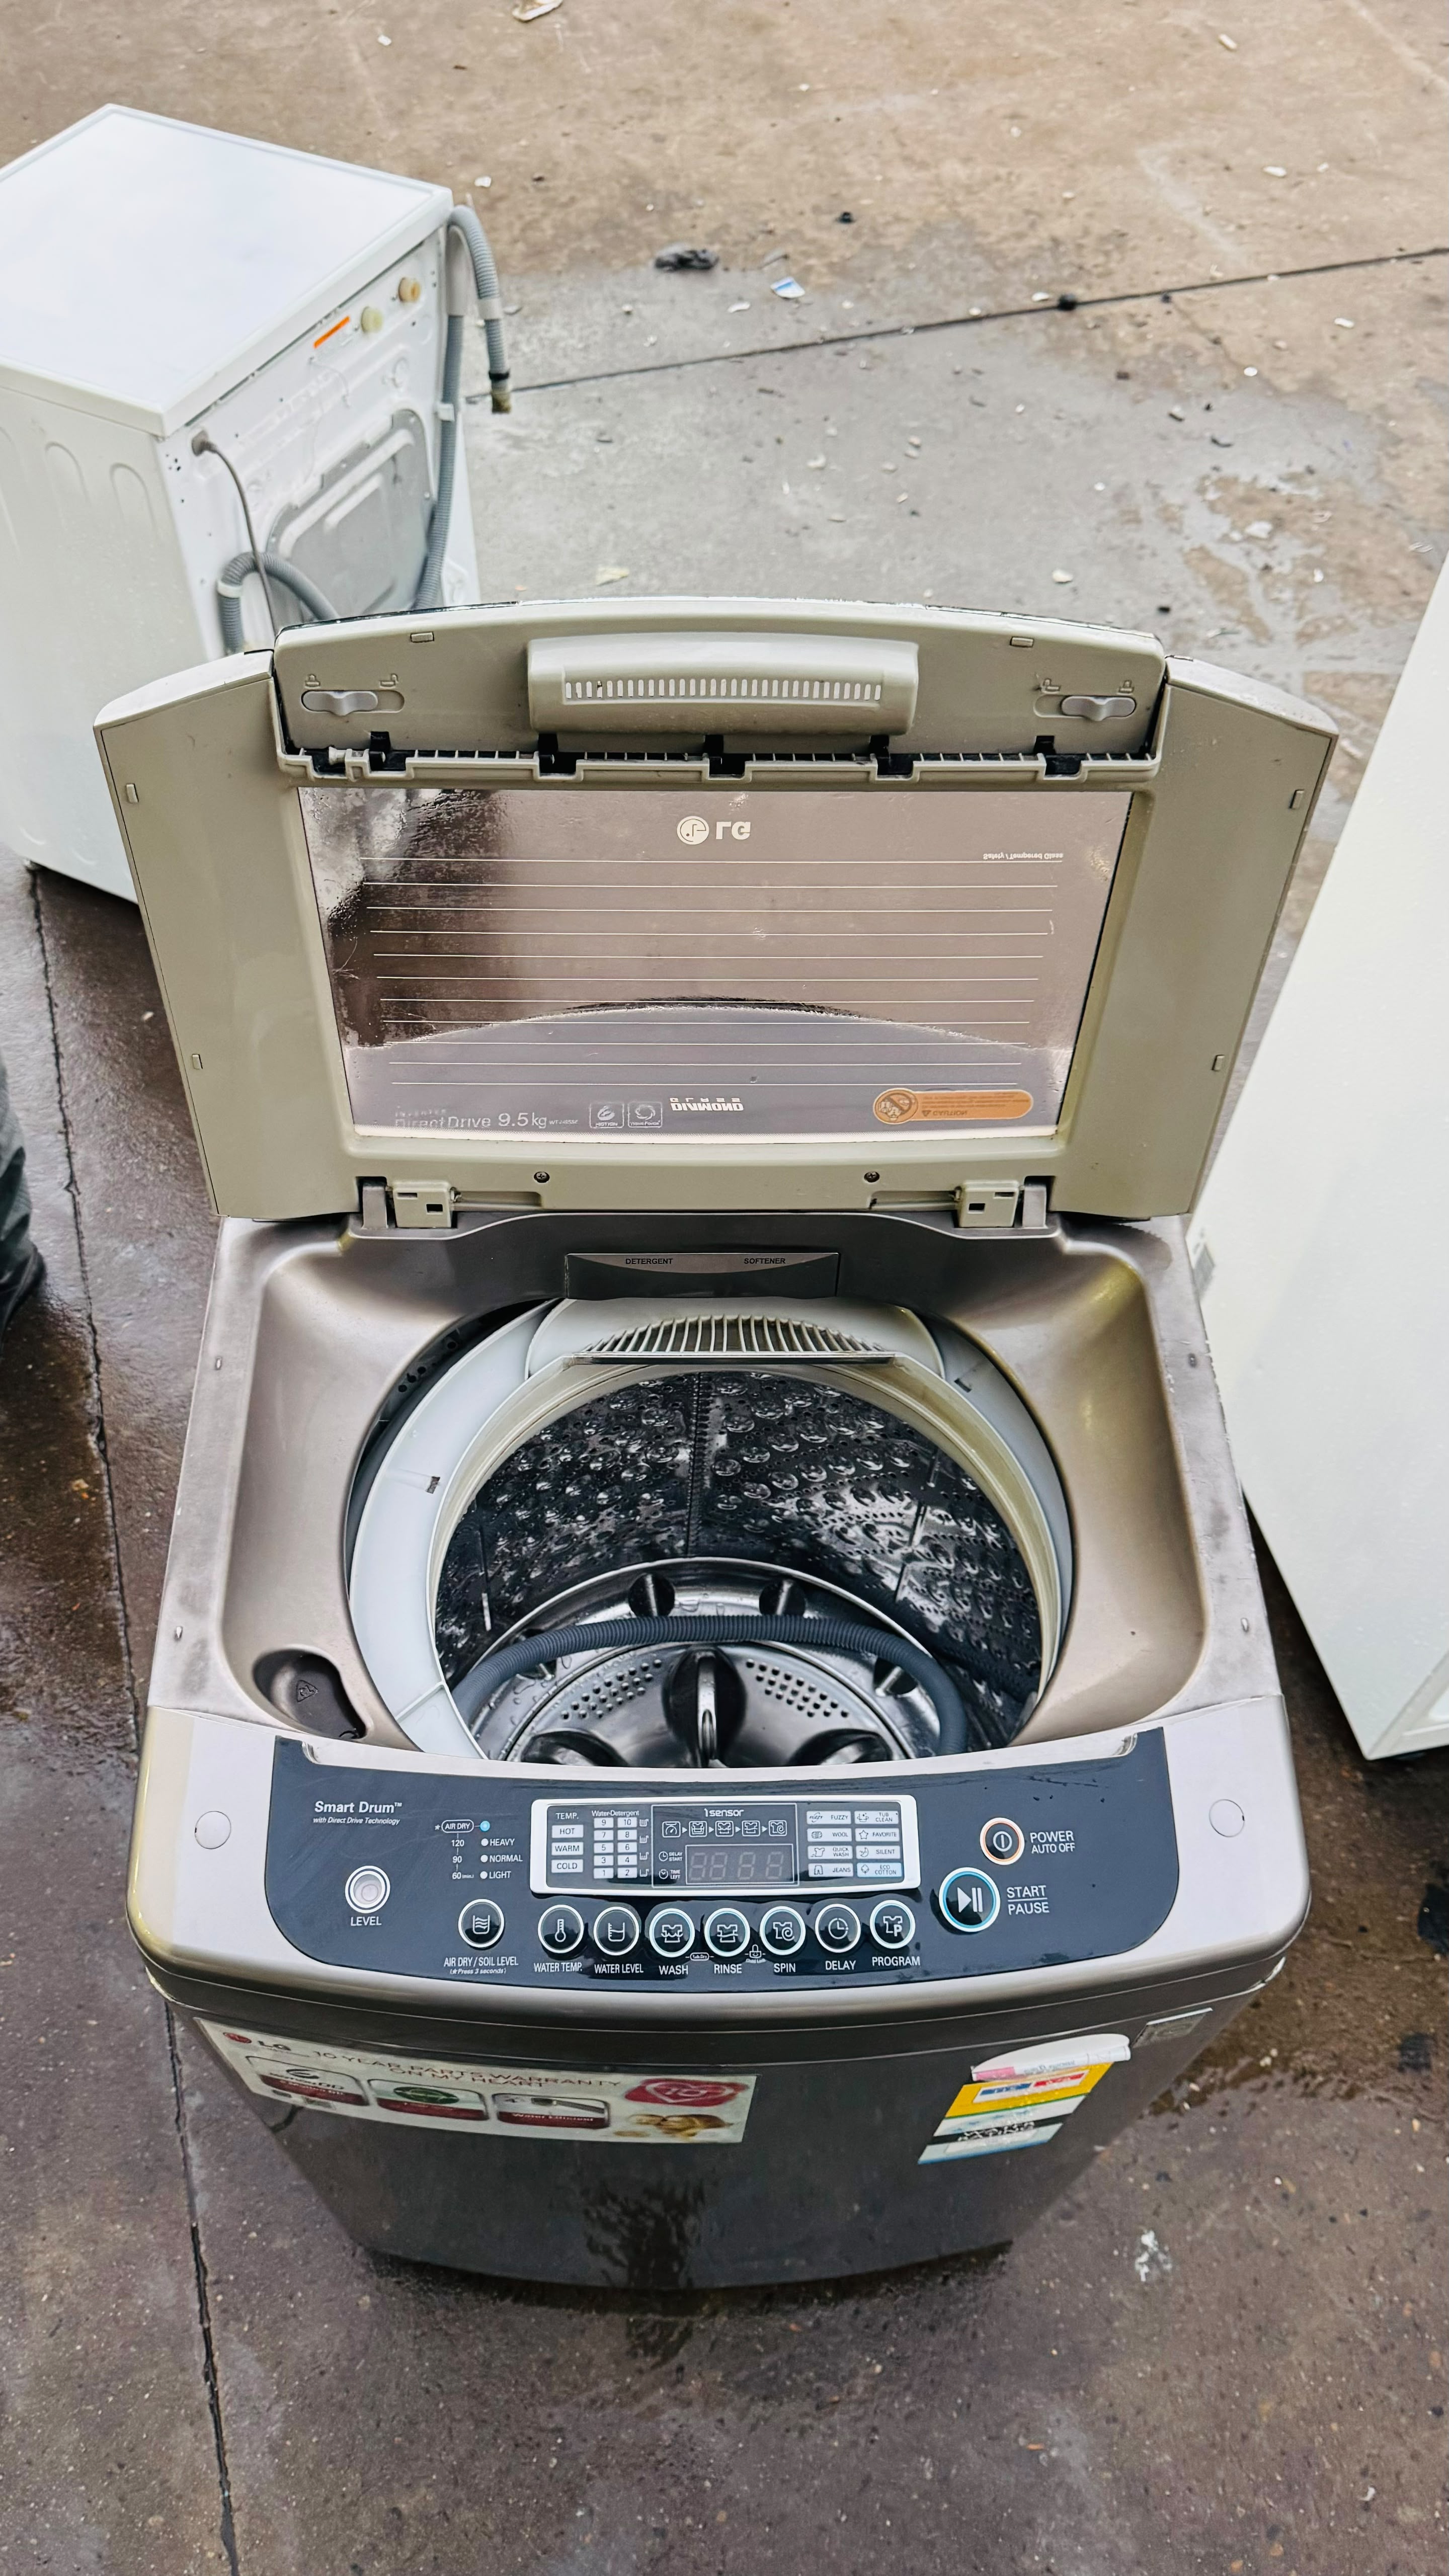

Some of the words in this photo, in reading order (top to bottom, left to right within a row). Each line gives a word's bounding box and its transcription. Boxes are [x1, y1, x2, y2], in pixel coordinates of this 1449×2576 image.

[314, 1801, 355, 1813] Smart
[365, 1817, 400, 1825] Technology
[1030, 1830, 1075, 1843] POWER
[1031, 1843, 1057, 1854] AUTO
[1059, 1842, 1075, 1853] OFF
[490, 1855, 523, 1863] NORMAL
[489, 1871, 512, 1879] LIGHT
[1007, 1885, 1046, 1898] START
[1008, 1902, 1050, 1915] PAUSE
[351, 1916, 382, 1926] LEVEL
[444, 1957, 456, 1967] AIR
[458, 1957, 473, 1967] DRY
[478, 1957, 495, 1966] SOIL
[497, 1956, 519, 1966] LEVEL
[825, 1960, 856, 1971] DELAY
[872, 1956, 920, 1966] PROGRAM
[534, 1963, 559, 1972] WATER
[560, 1962, 583, 1972] TEMP.
[594, 1964, 620, 1974] WATER
[621, 1964, 644, 1974] LEVEL
[659, 1965, 689, 1975] WASH
[714, 1964, 742, 1974] RINSE
[773, 1963, 796, 1973] SPIN
[342, 2055, 400, 2068] YEAR
[410, 2064, 483, 2078] PARTS
[491, 2074, 621, 2086] WARRANTY
